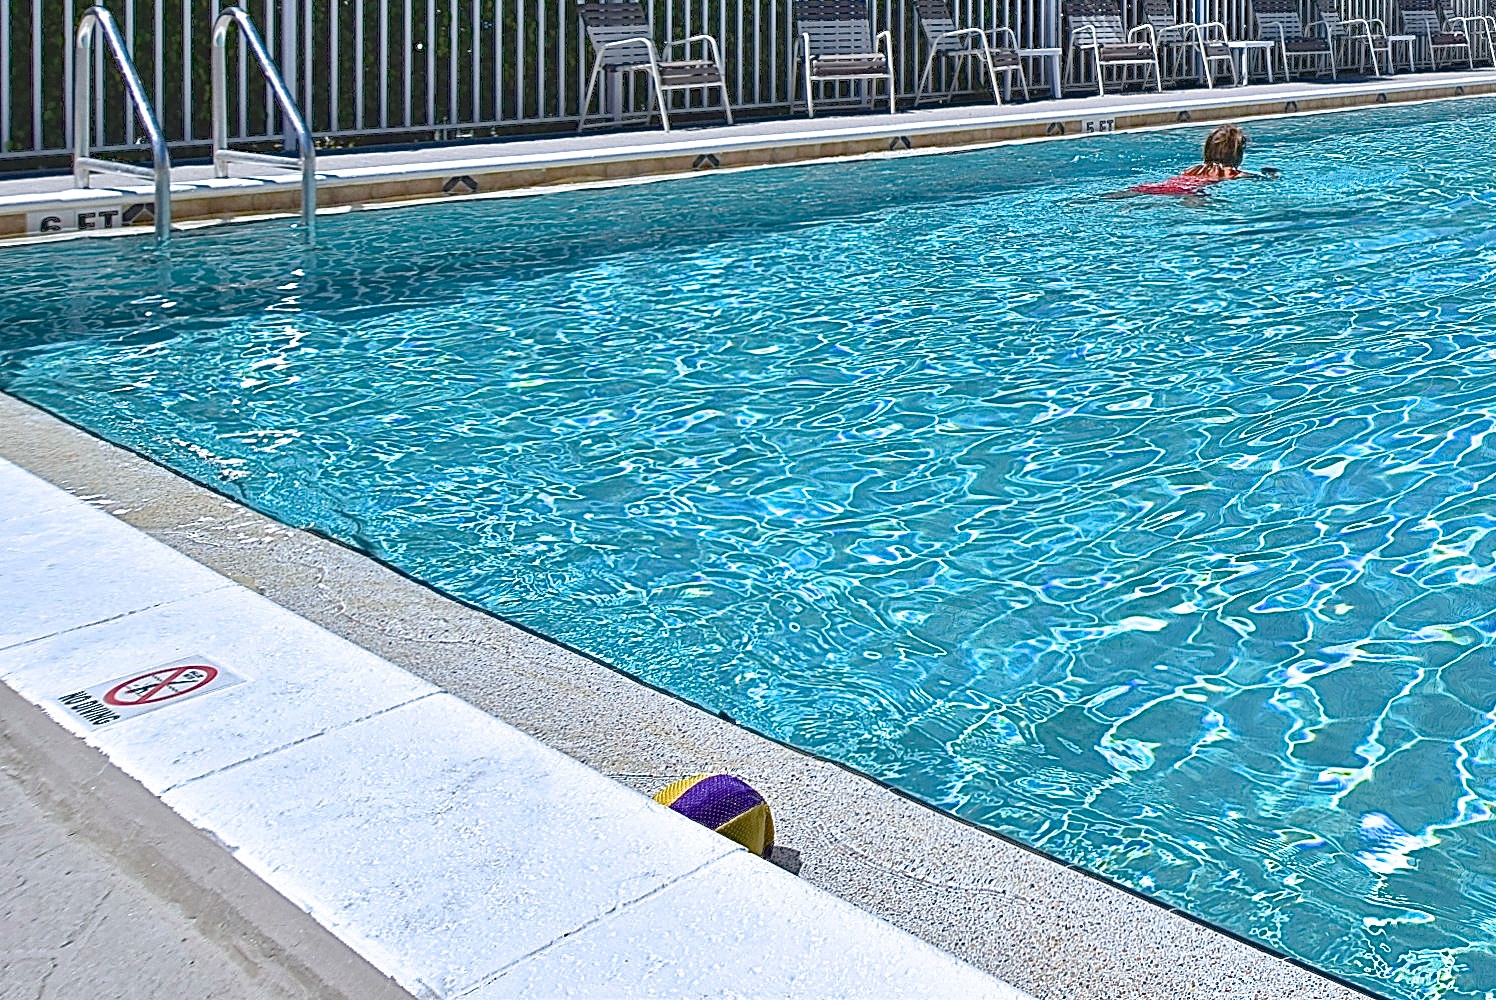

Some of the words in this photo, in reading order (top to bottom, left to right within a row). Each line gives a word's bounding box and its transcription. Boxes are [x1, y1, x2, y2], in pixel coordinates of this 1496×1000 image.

[1086, 121, 1095, 132] 5
[1099, 119, 1114, 132] FT
[77, 210, 119, 230] FT
[57, 690, 92, 705] NO
[70, 699, 121, 726] DIVING
